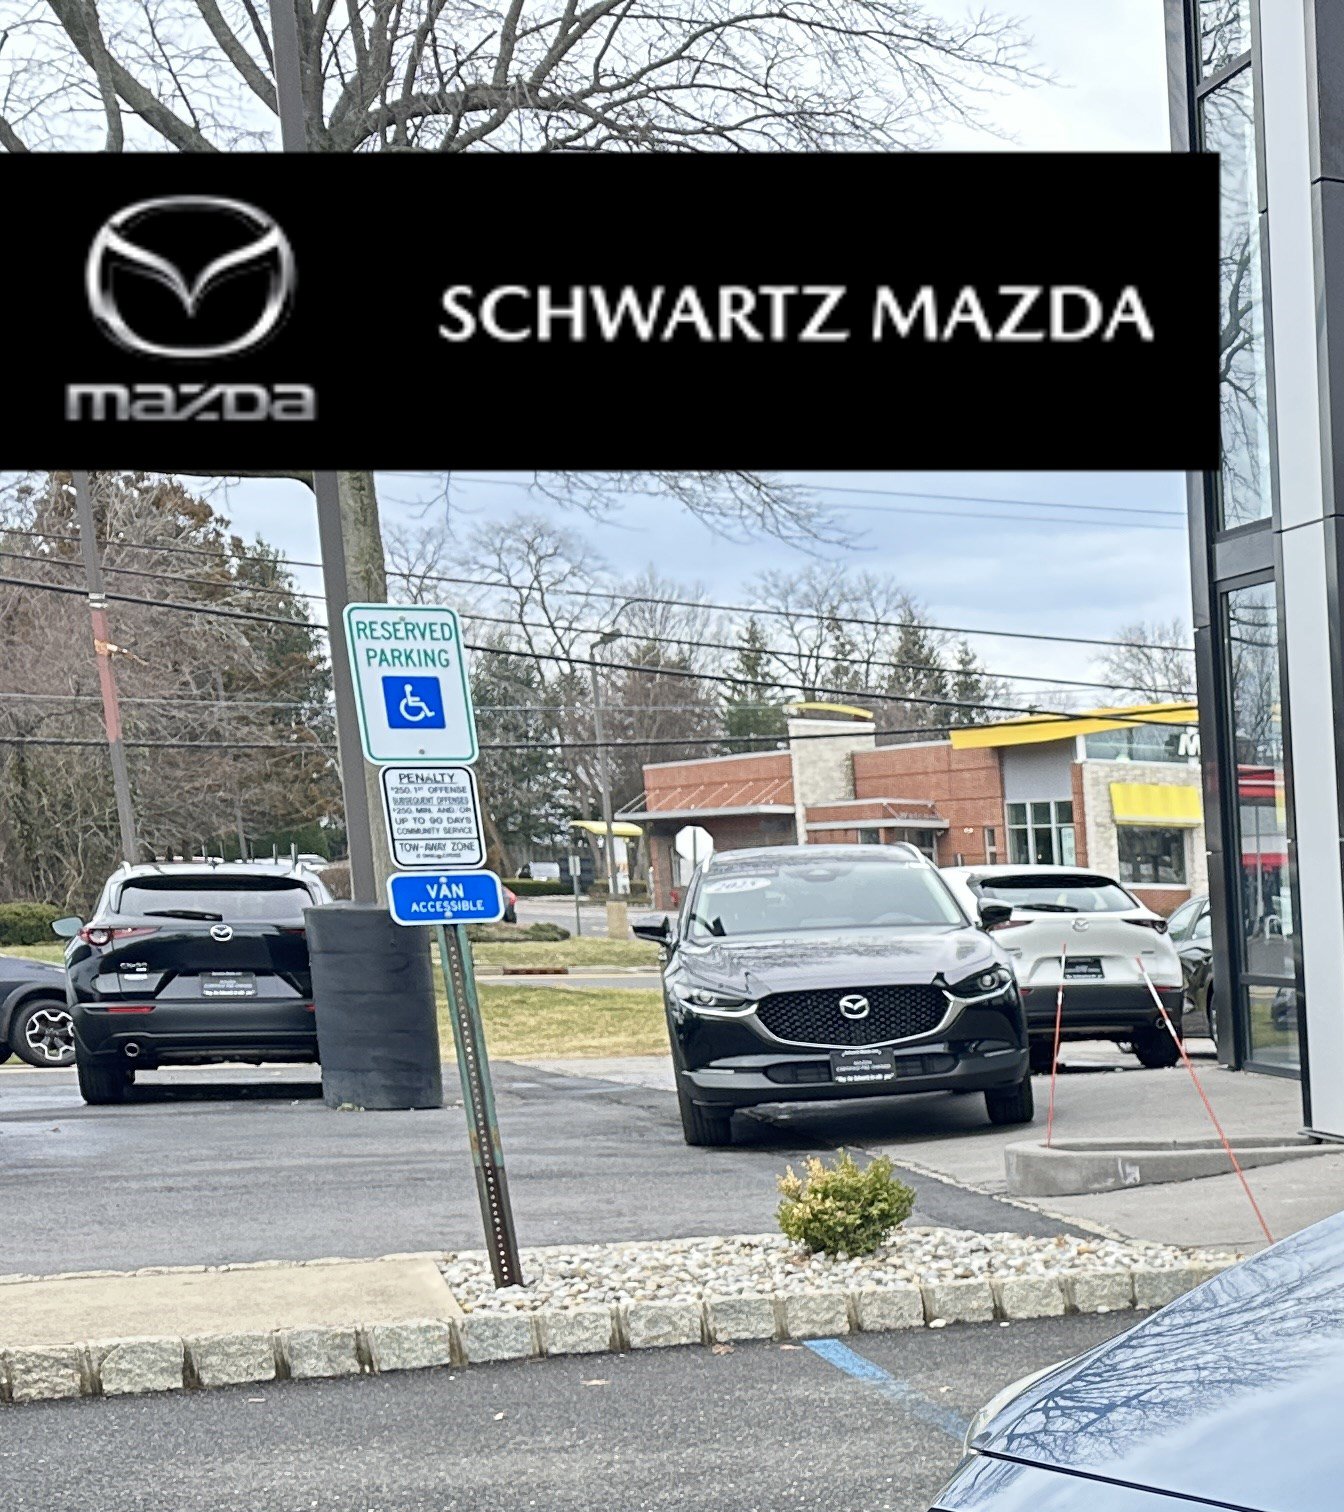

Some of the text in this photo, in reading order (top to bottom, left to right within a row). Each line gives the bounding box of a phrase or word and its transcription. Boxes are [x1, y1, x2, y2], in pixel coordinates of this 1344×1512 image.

[356, 620, 453, 641] RESERVED
[365, 648, 450, 668] PARKING
[399, 773, 455, 783] PENALTY
[428, 786, 467, 794] OFFENSE
[395, 817, 408, 825] UP
[447, 816, 472, 824] DAYS
[400, 841, 475, 852] TOW-AWAY ZONE
[426, 883, 465, 899] VAN
[411, 899, 485, 913] ACCESSIBLE
